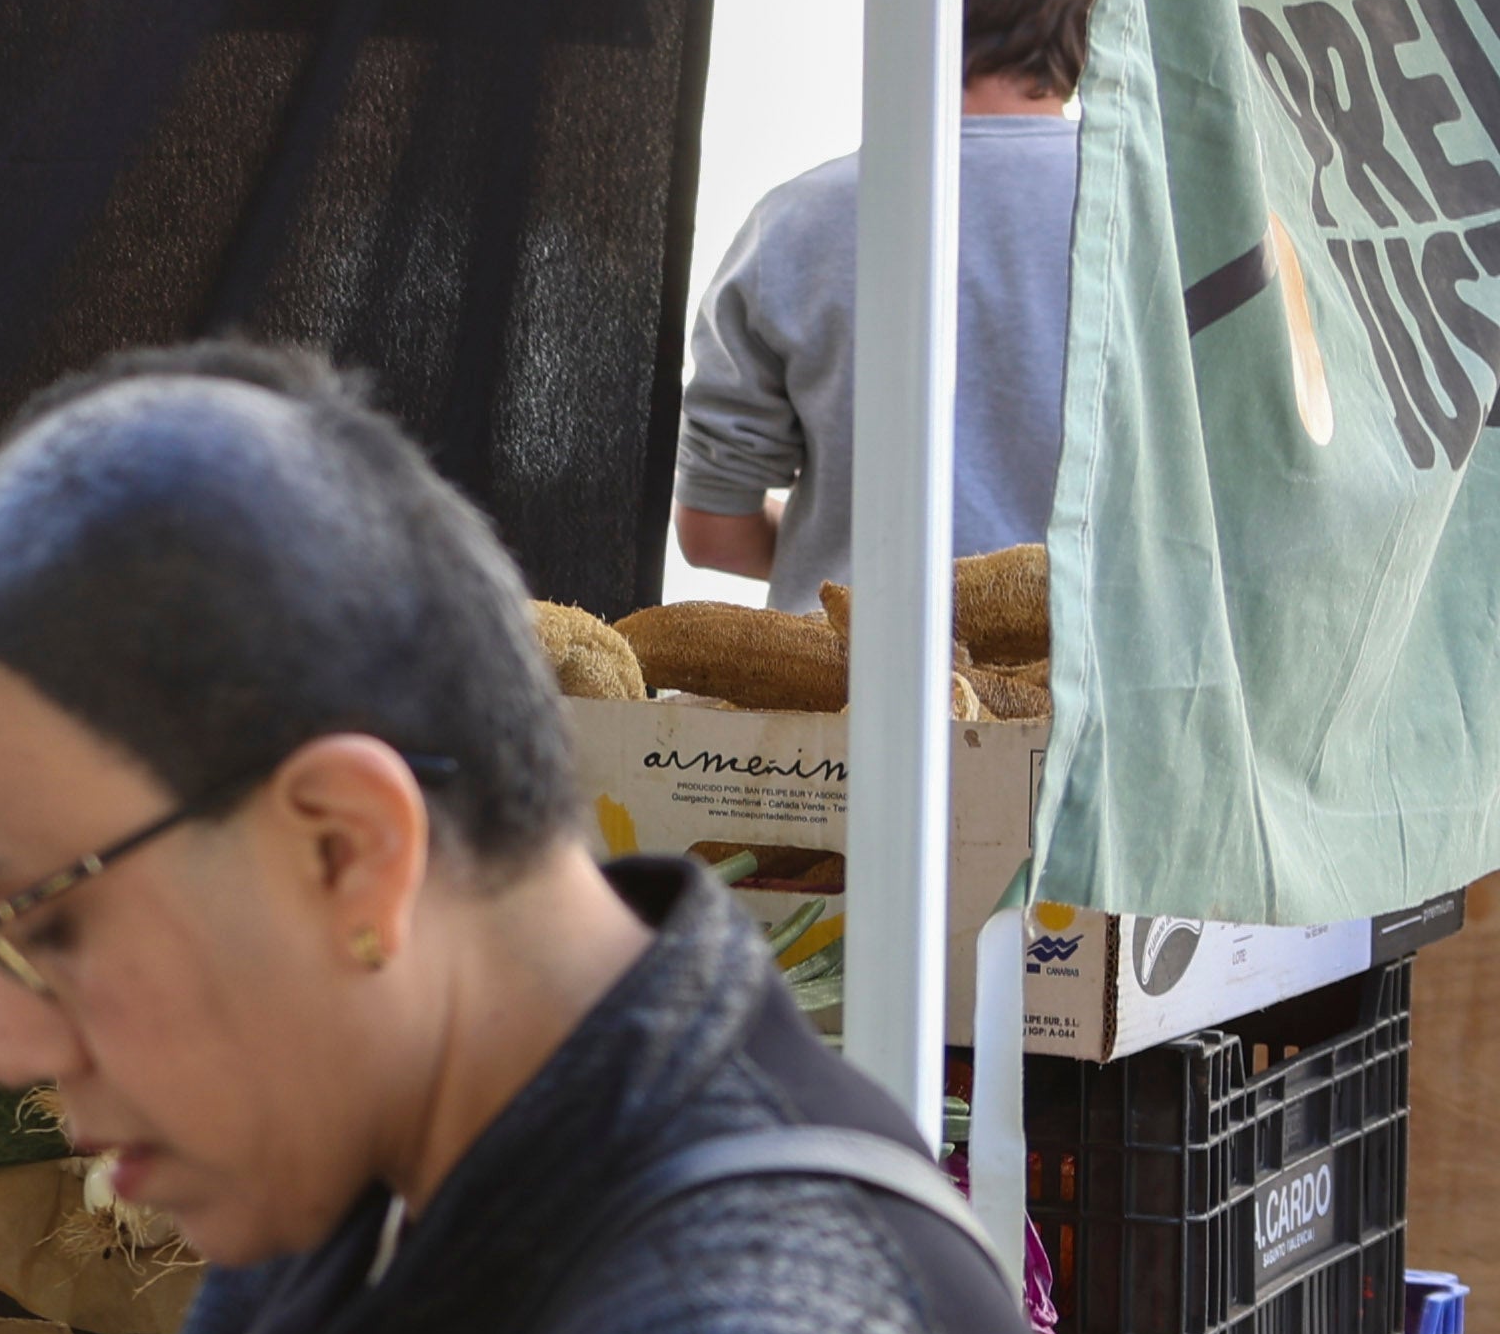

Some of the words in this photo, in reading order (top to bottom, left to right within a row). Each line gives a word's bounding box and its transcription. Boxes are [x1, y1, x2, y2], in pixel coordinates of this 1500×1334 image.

[1325, 223, 1500, 471] JUS
[643, 748, 848, 782] armeñim
[677, 782, 722, 793] PRODUCIDO
[724, 785, 742, 794] POR:
[744, 786, 760, 795] SAN
[761, 788, 788, 797] FELIPE
[789, 789, 805, 798] SUR
[815, 791, 847, 801] ASOCIAD
[671, 793, 715, 804] Guargacho
[768, 799, 800, 810] Cañada
[801, 802, 826, 812] Verde
[1046, 966, 1080, 977] CANARIAS
[1024, 1015, 1042, 1026] LIPE
[1043, 1016, 1063, 1028] SUR,
[1065, 1018, 1080, 1028] S.L.
[1028, 1028, 1047, 1038] IGP:
[1049, 1029, 1077, 1040] A-044
